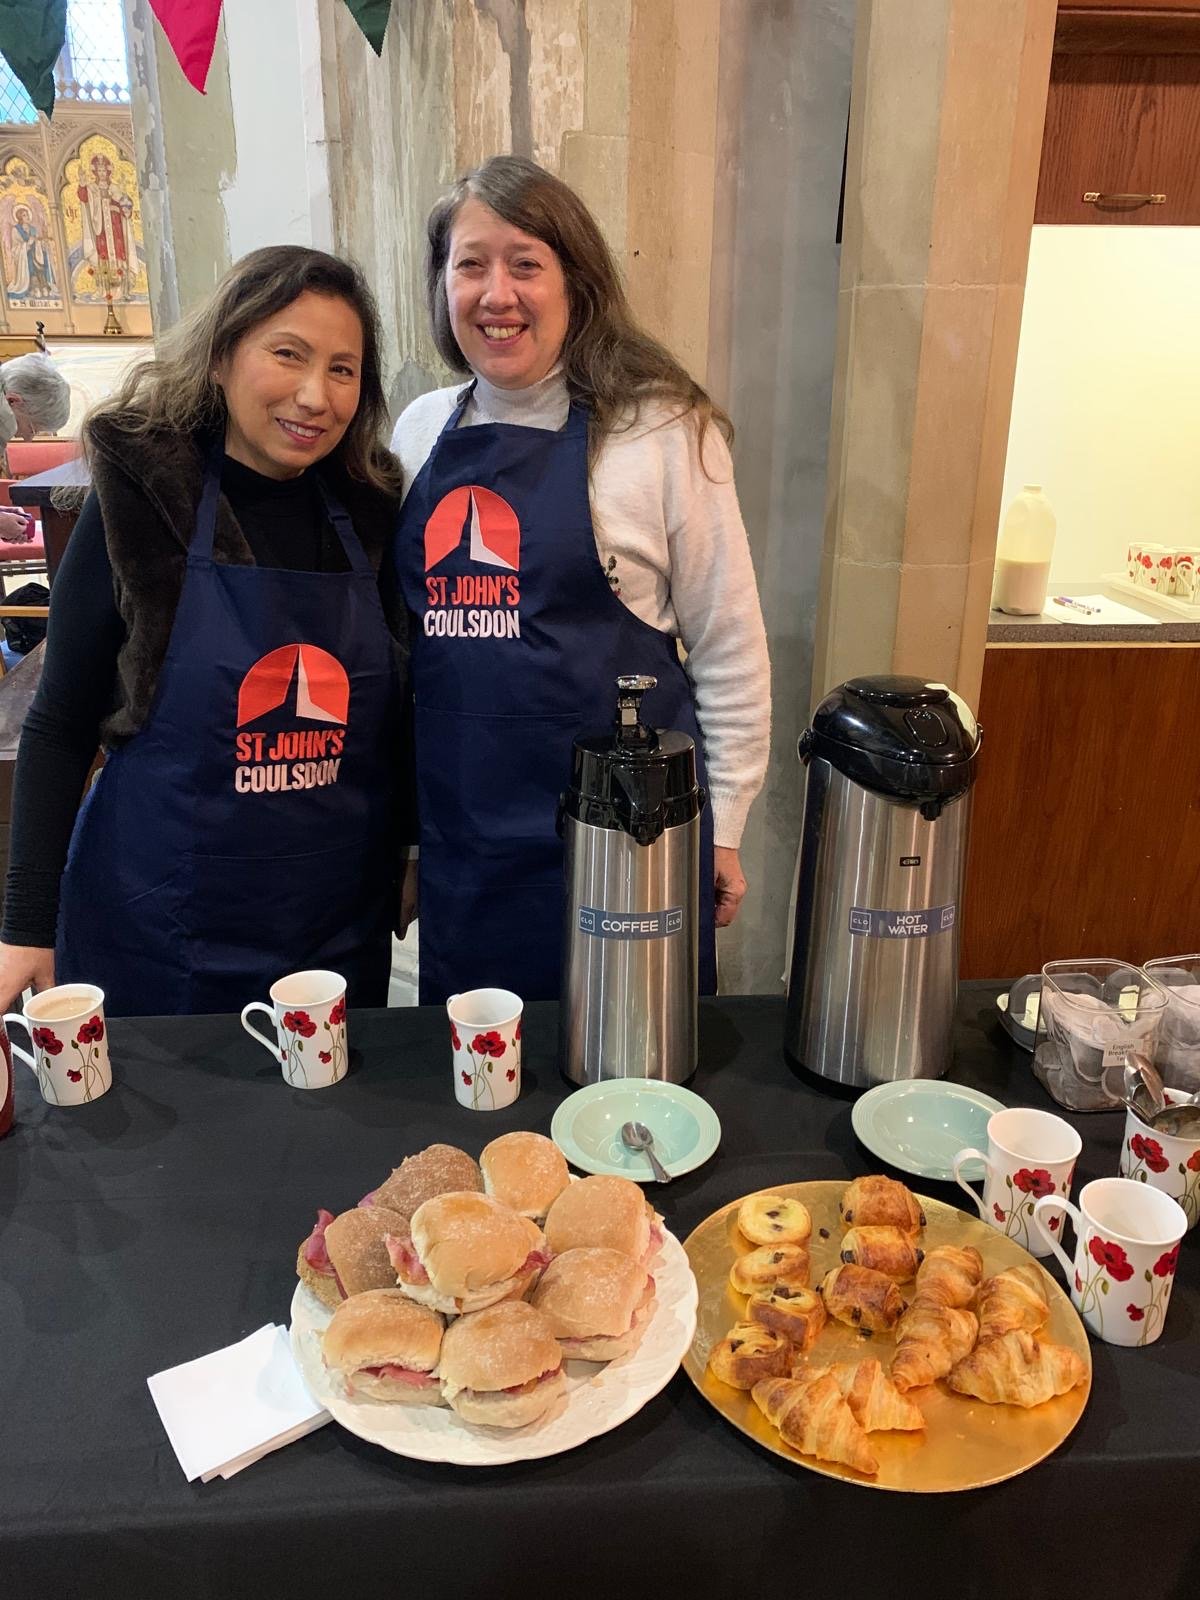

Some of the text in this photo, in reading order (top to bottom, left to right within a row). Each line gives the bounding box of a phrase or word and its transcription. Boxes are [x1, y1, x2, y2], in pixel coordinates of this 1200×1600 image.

[425, 575, 521, 606] ST JOHN'S
[423, 609, 521, 639] COULSDON
[236, 729, 346, 762] ST JOHN'S
[234, 758, 342, 794] COULSDON
[580, 916, 593, 925] CLO
[601, 919, 659, 933] COFFEE
[668, 918, 681, 926] CLO
[896, 915, 922, 925] HOT
[887, 924, 928, 935] WATER
